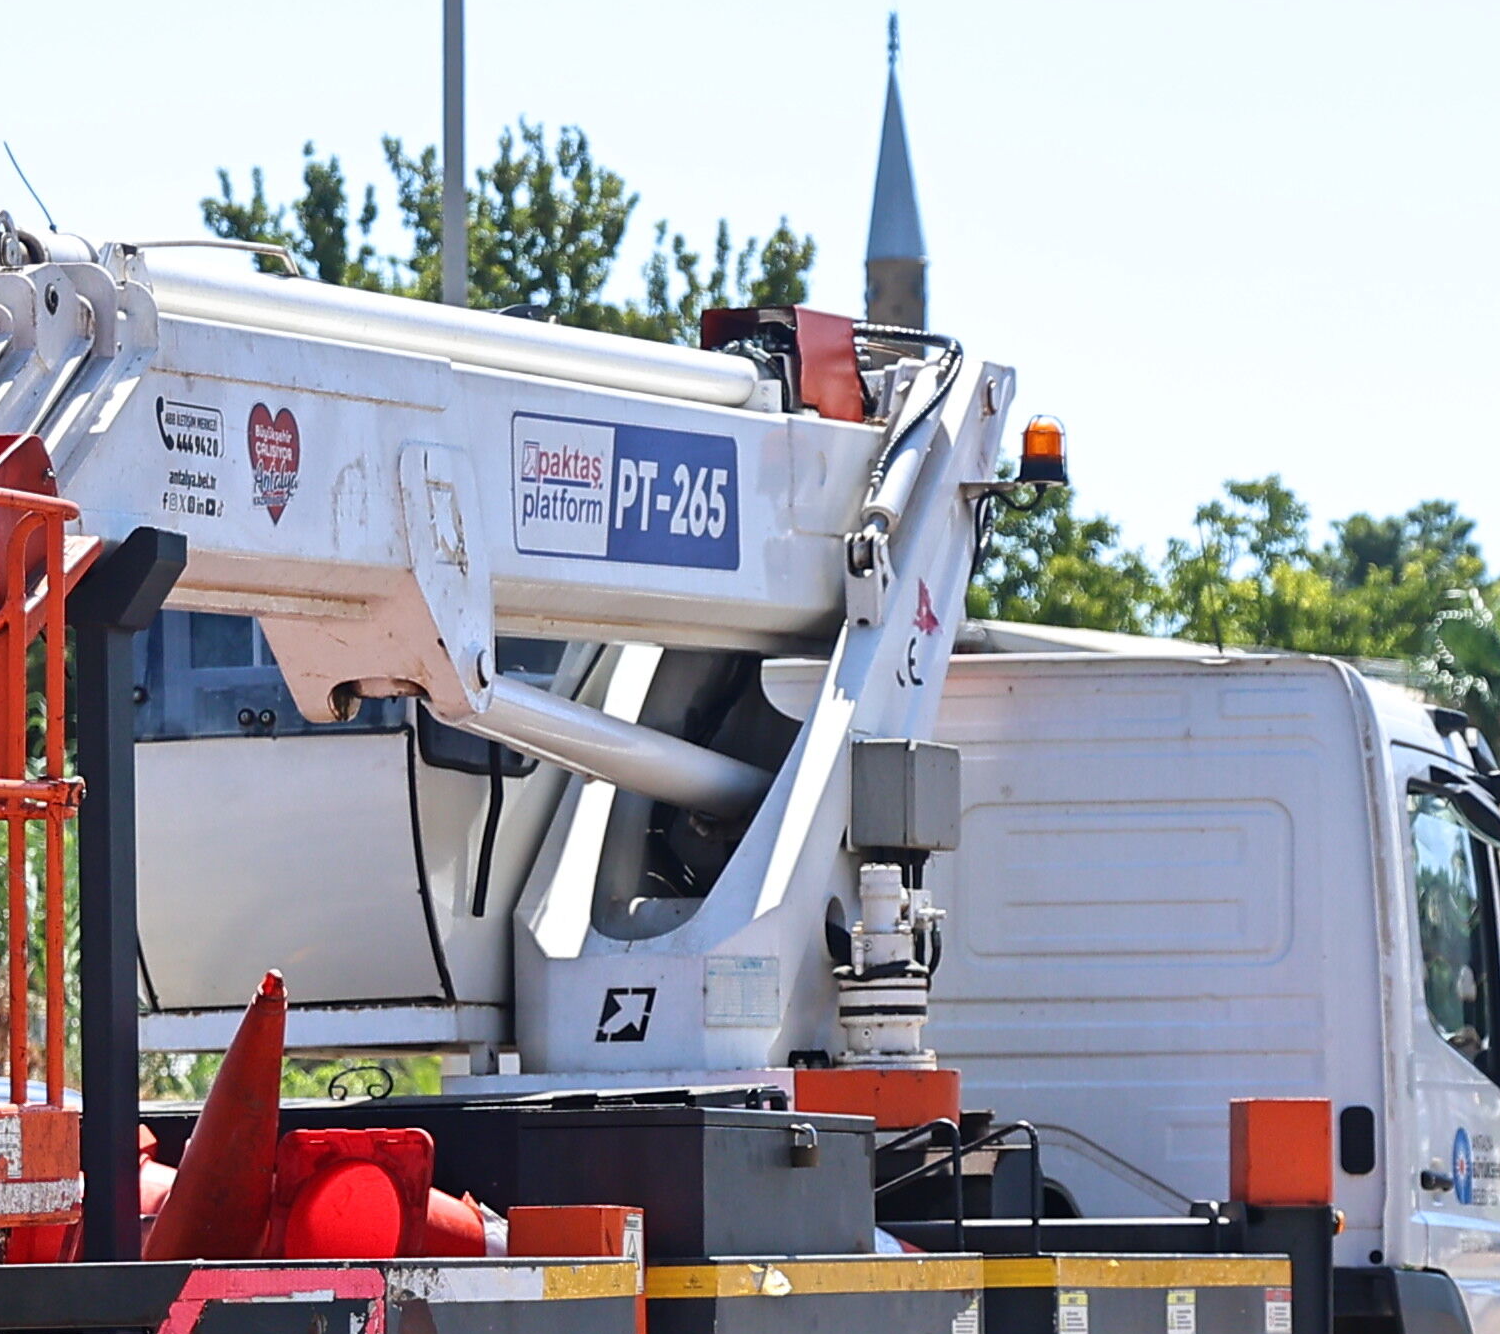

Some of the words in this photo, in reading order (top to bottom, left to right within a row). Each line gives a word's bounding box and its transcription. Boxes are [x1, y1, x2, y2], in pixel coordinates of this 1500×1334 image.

[169, 469, 217, 491] antalya.bel.tr
[254, 459, 299, 499] Antalya
[538, 445, 603, 489] paktaş
[522, 484, 602, 526] platform
[615, 458, 728, 539] PT-265
